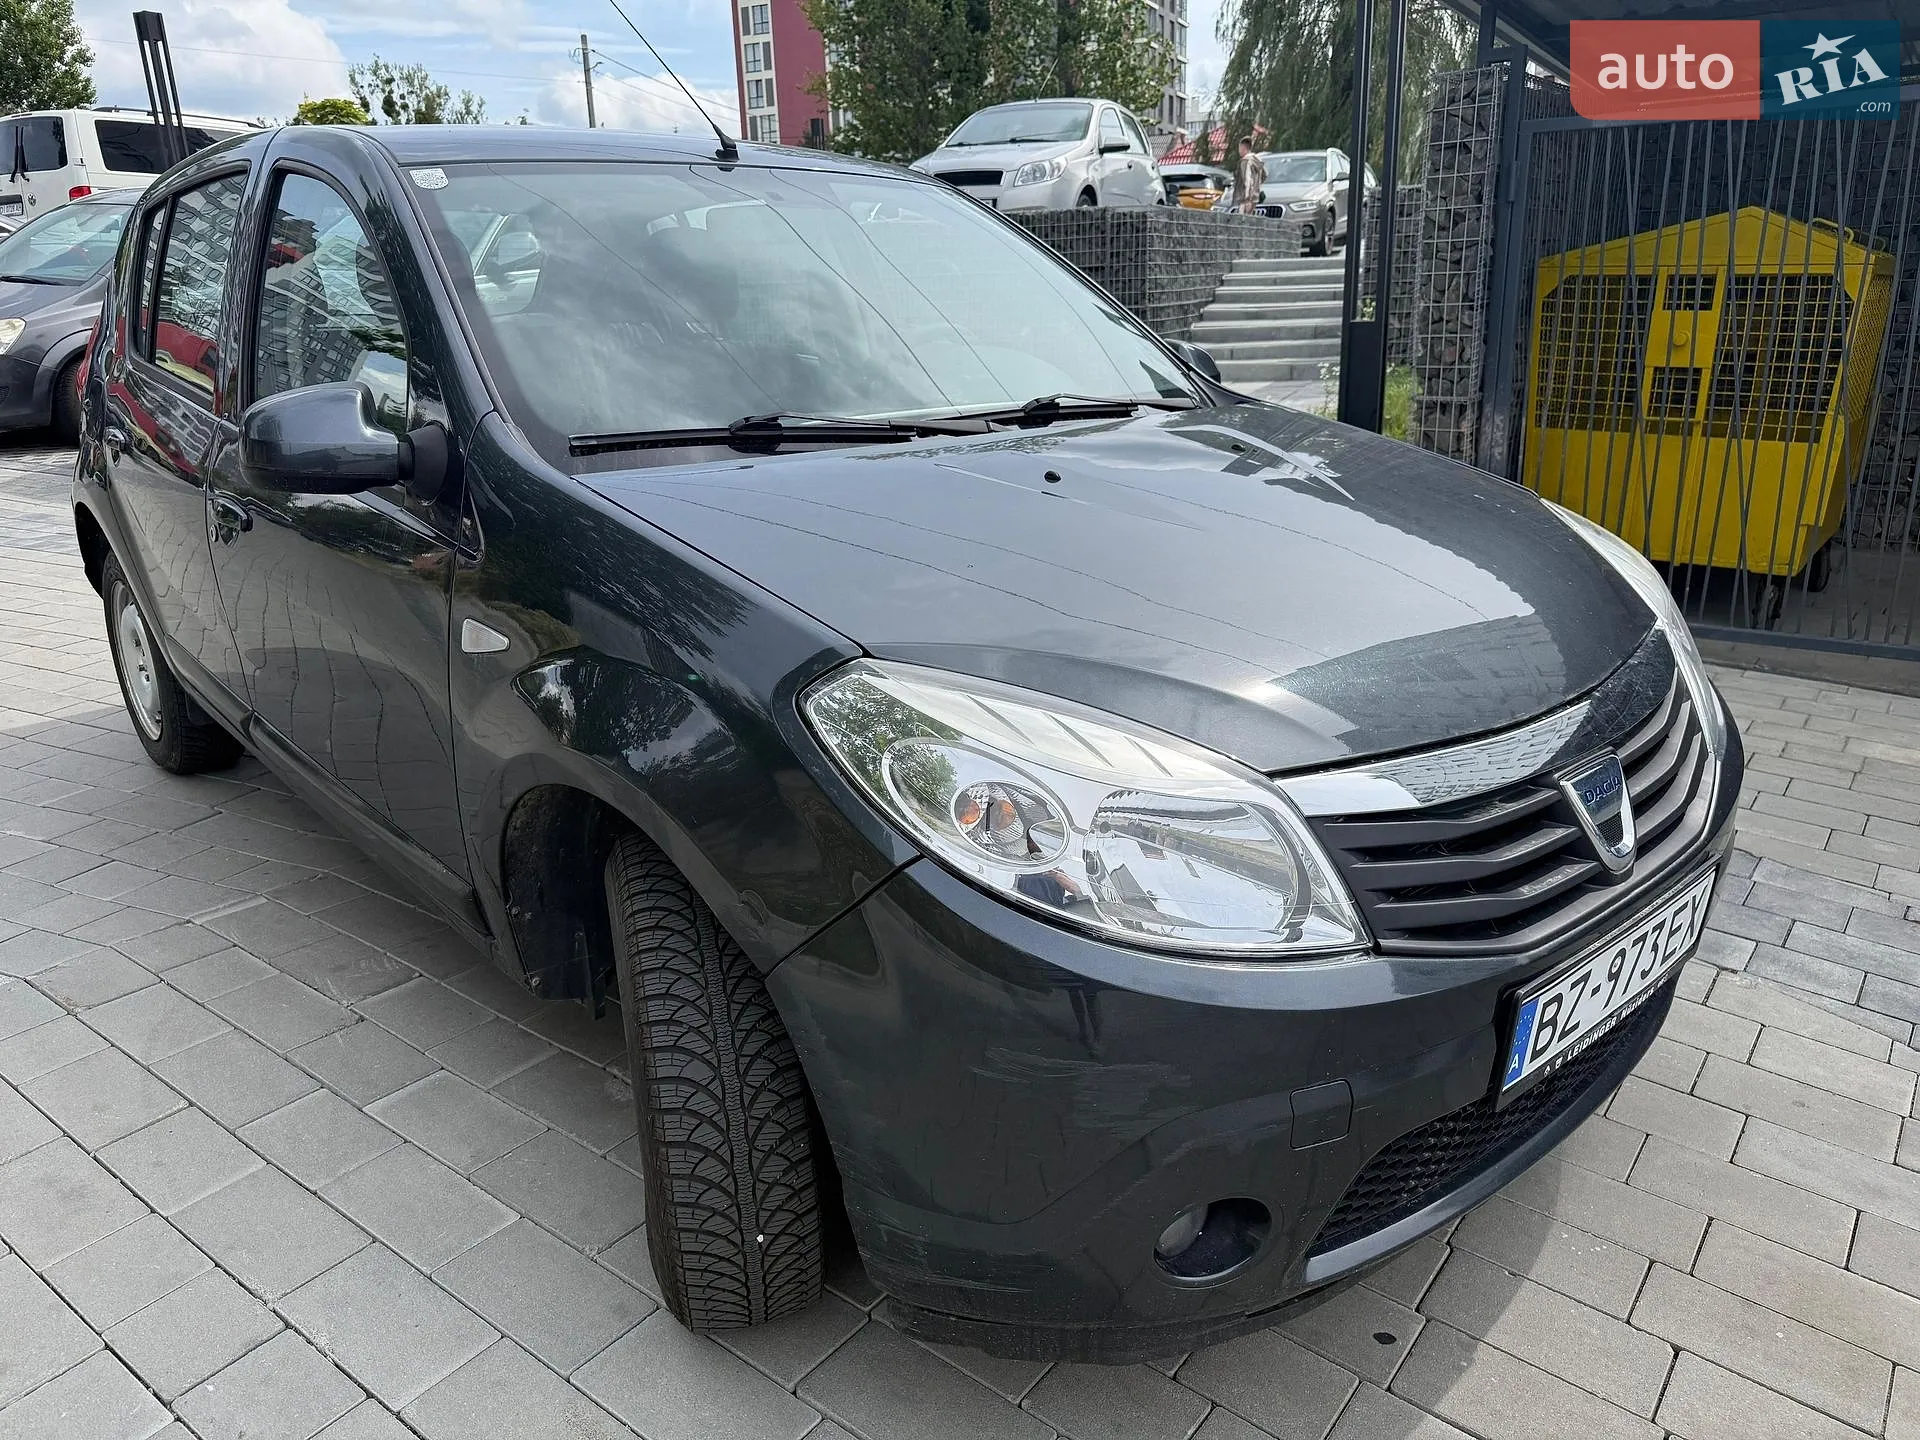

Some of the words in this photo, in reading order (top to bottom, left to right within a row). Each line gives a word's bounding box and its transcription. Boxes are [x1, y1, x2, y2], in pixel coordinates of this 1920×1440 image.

[1584, 776, 1621, 805] DACIA
[1567, 1016, 1617, 1061] LEIDINGER
[1508, 1053, 1519, 1074] A
